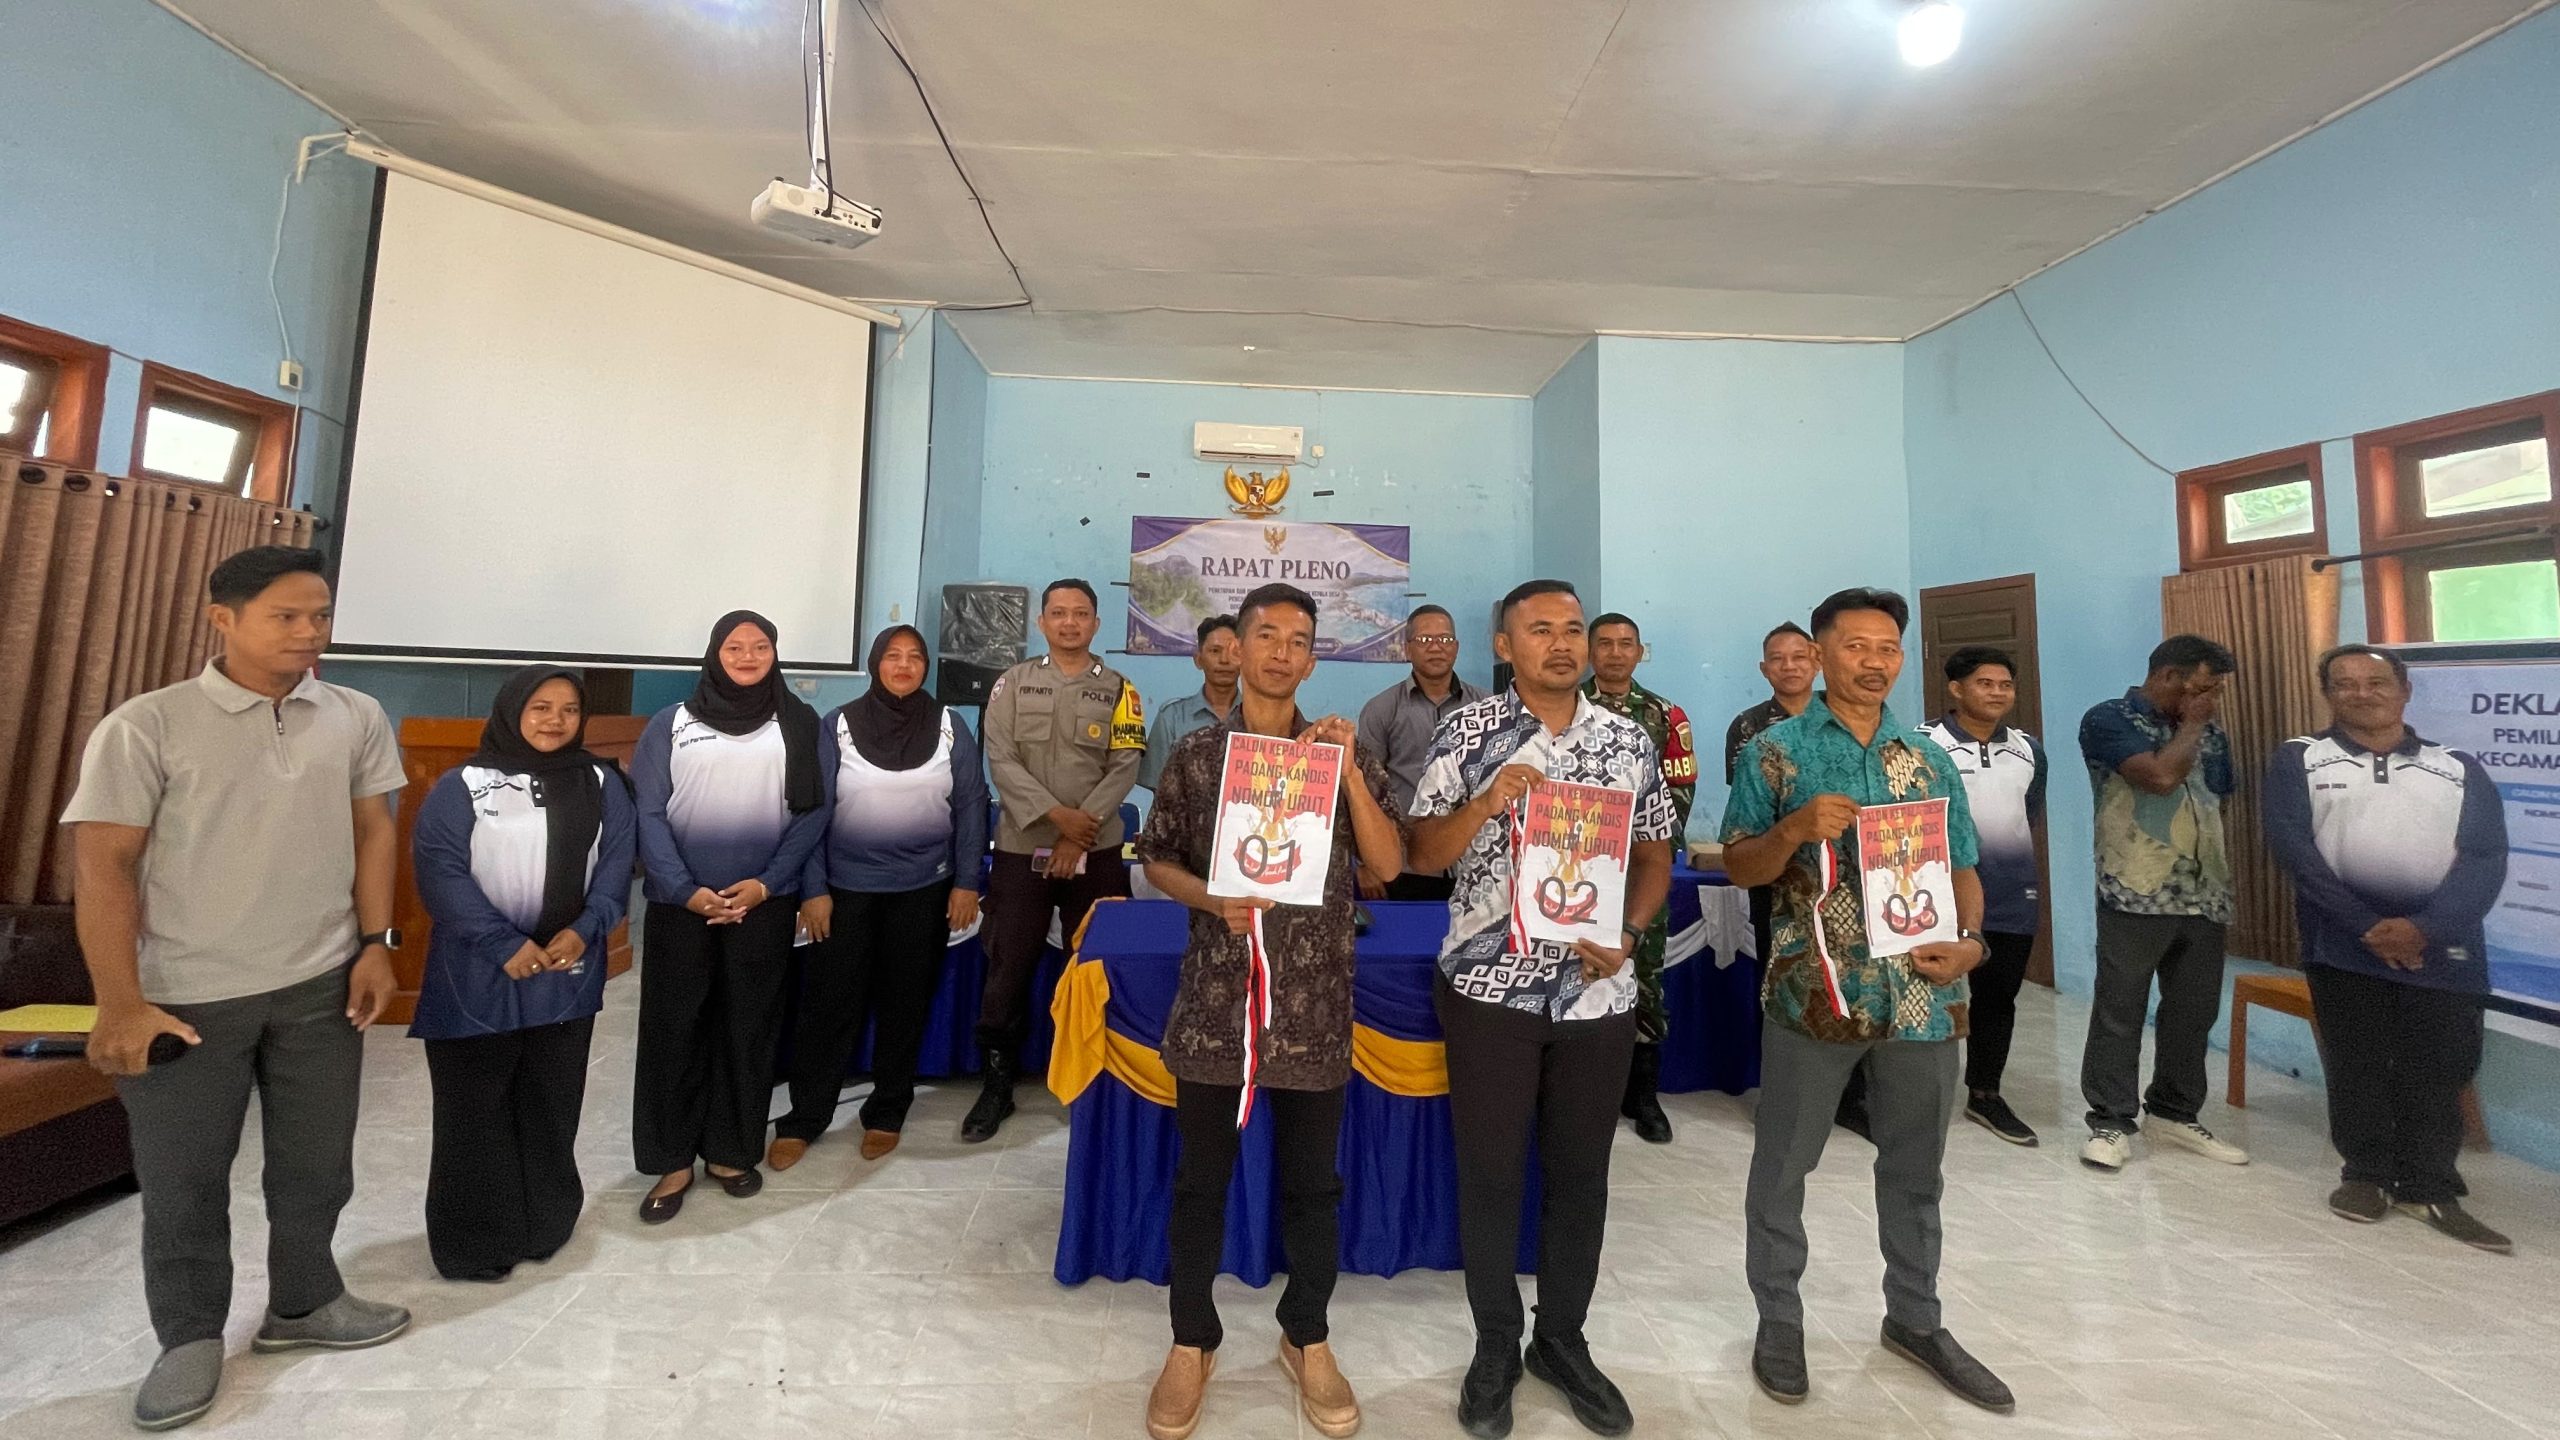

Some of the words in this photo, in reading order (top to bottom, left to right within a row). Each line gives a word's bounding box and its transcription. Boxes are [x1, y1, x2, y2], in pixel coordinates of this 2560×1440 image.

[1201, 556, 1274, 579] RAPAT
[1280, 559, 1351, 581] PLENO
[1081, 690, 1114, 705] POLRI
[2470, 693, 2560, 716] DEKL
[1231, 736, 1267, 754] CALON
[1269, 741, 1308, 758] KEPALA
[1311, 747, 1338, 762] DESA
[1235, 759, 1283, 779] PADANG
[1285, 766, 1329, 784] KANDIS
[1231, 786, 1282, 809] NOMOR
[1287, 793, 1326, 813] URUT
[1567, 786, 1603, 803] KEPALA
[1606, 792, 1632, 807] DESA
[1535, 803, 1580, 823] PADANG
[1582, 810, 1623, 829] KANDIS
[1531, 829, 1580, 851] NOMOR
[1584, 836, 1619, 856] URUT
[1866, 826, 1905, 844] PADANG
[1238, 834, 1296, 882] 01
[1868, 849, 1908, 870] NOMOR
[1912, 845, 1942, 864] URUT
[1538, 876, 1598, 925] 02
[1886, 889, 1939, 934] 03
